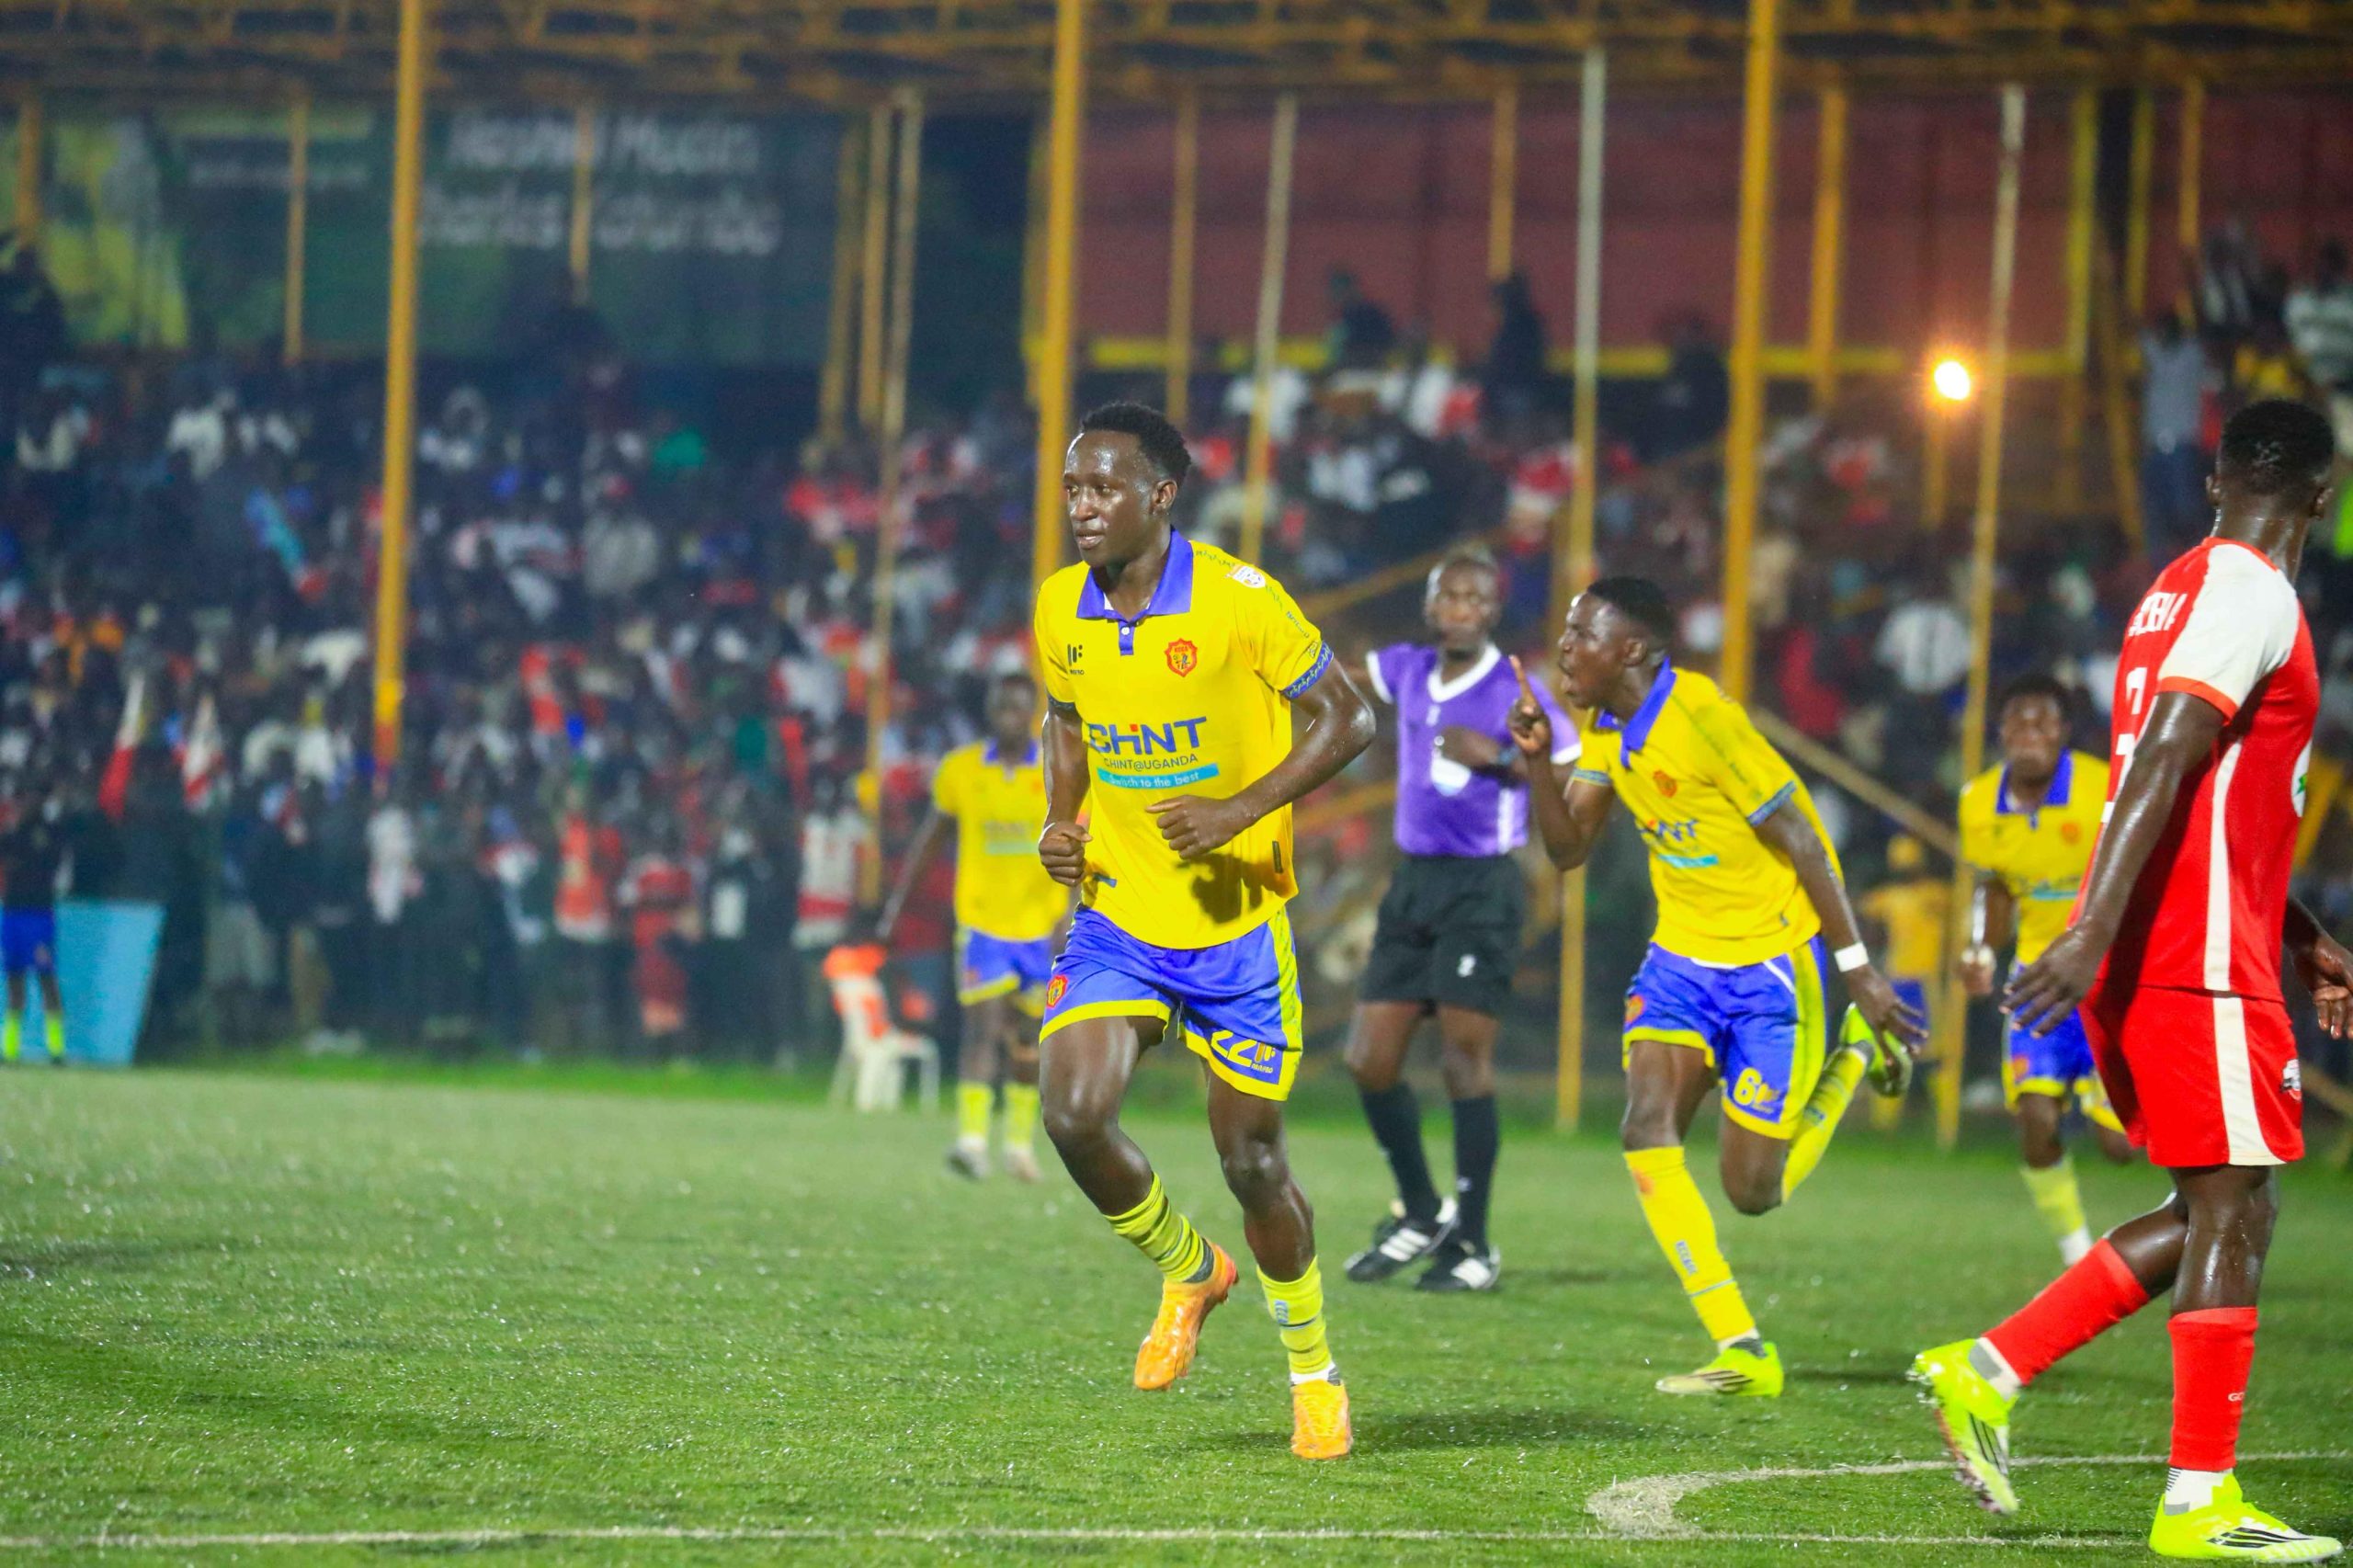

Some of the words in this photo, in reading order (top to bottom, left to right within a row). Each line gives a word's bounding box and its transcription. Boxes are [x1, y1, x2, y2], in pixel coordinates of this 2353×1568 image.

[1104, 753, 1199, 772] CHINT@UGANDA
[1140, 777, 1151, 788] to
[1154, 776, 1170, 787] the
[1174, 771, 1199, 785] best
[1733, 1067, 1762, 1105] 6
